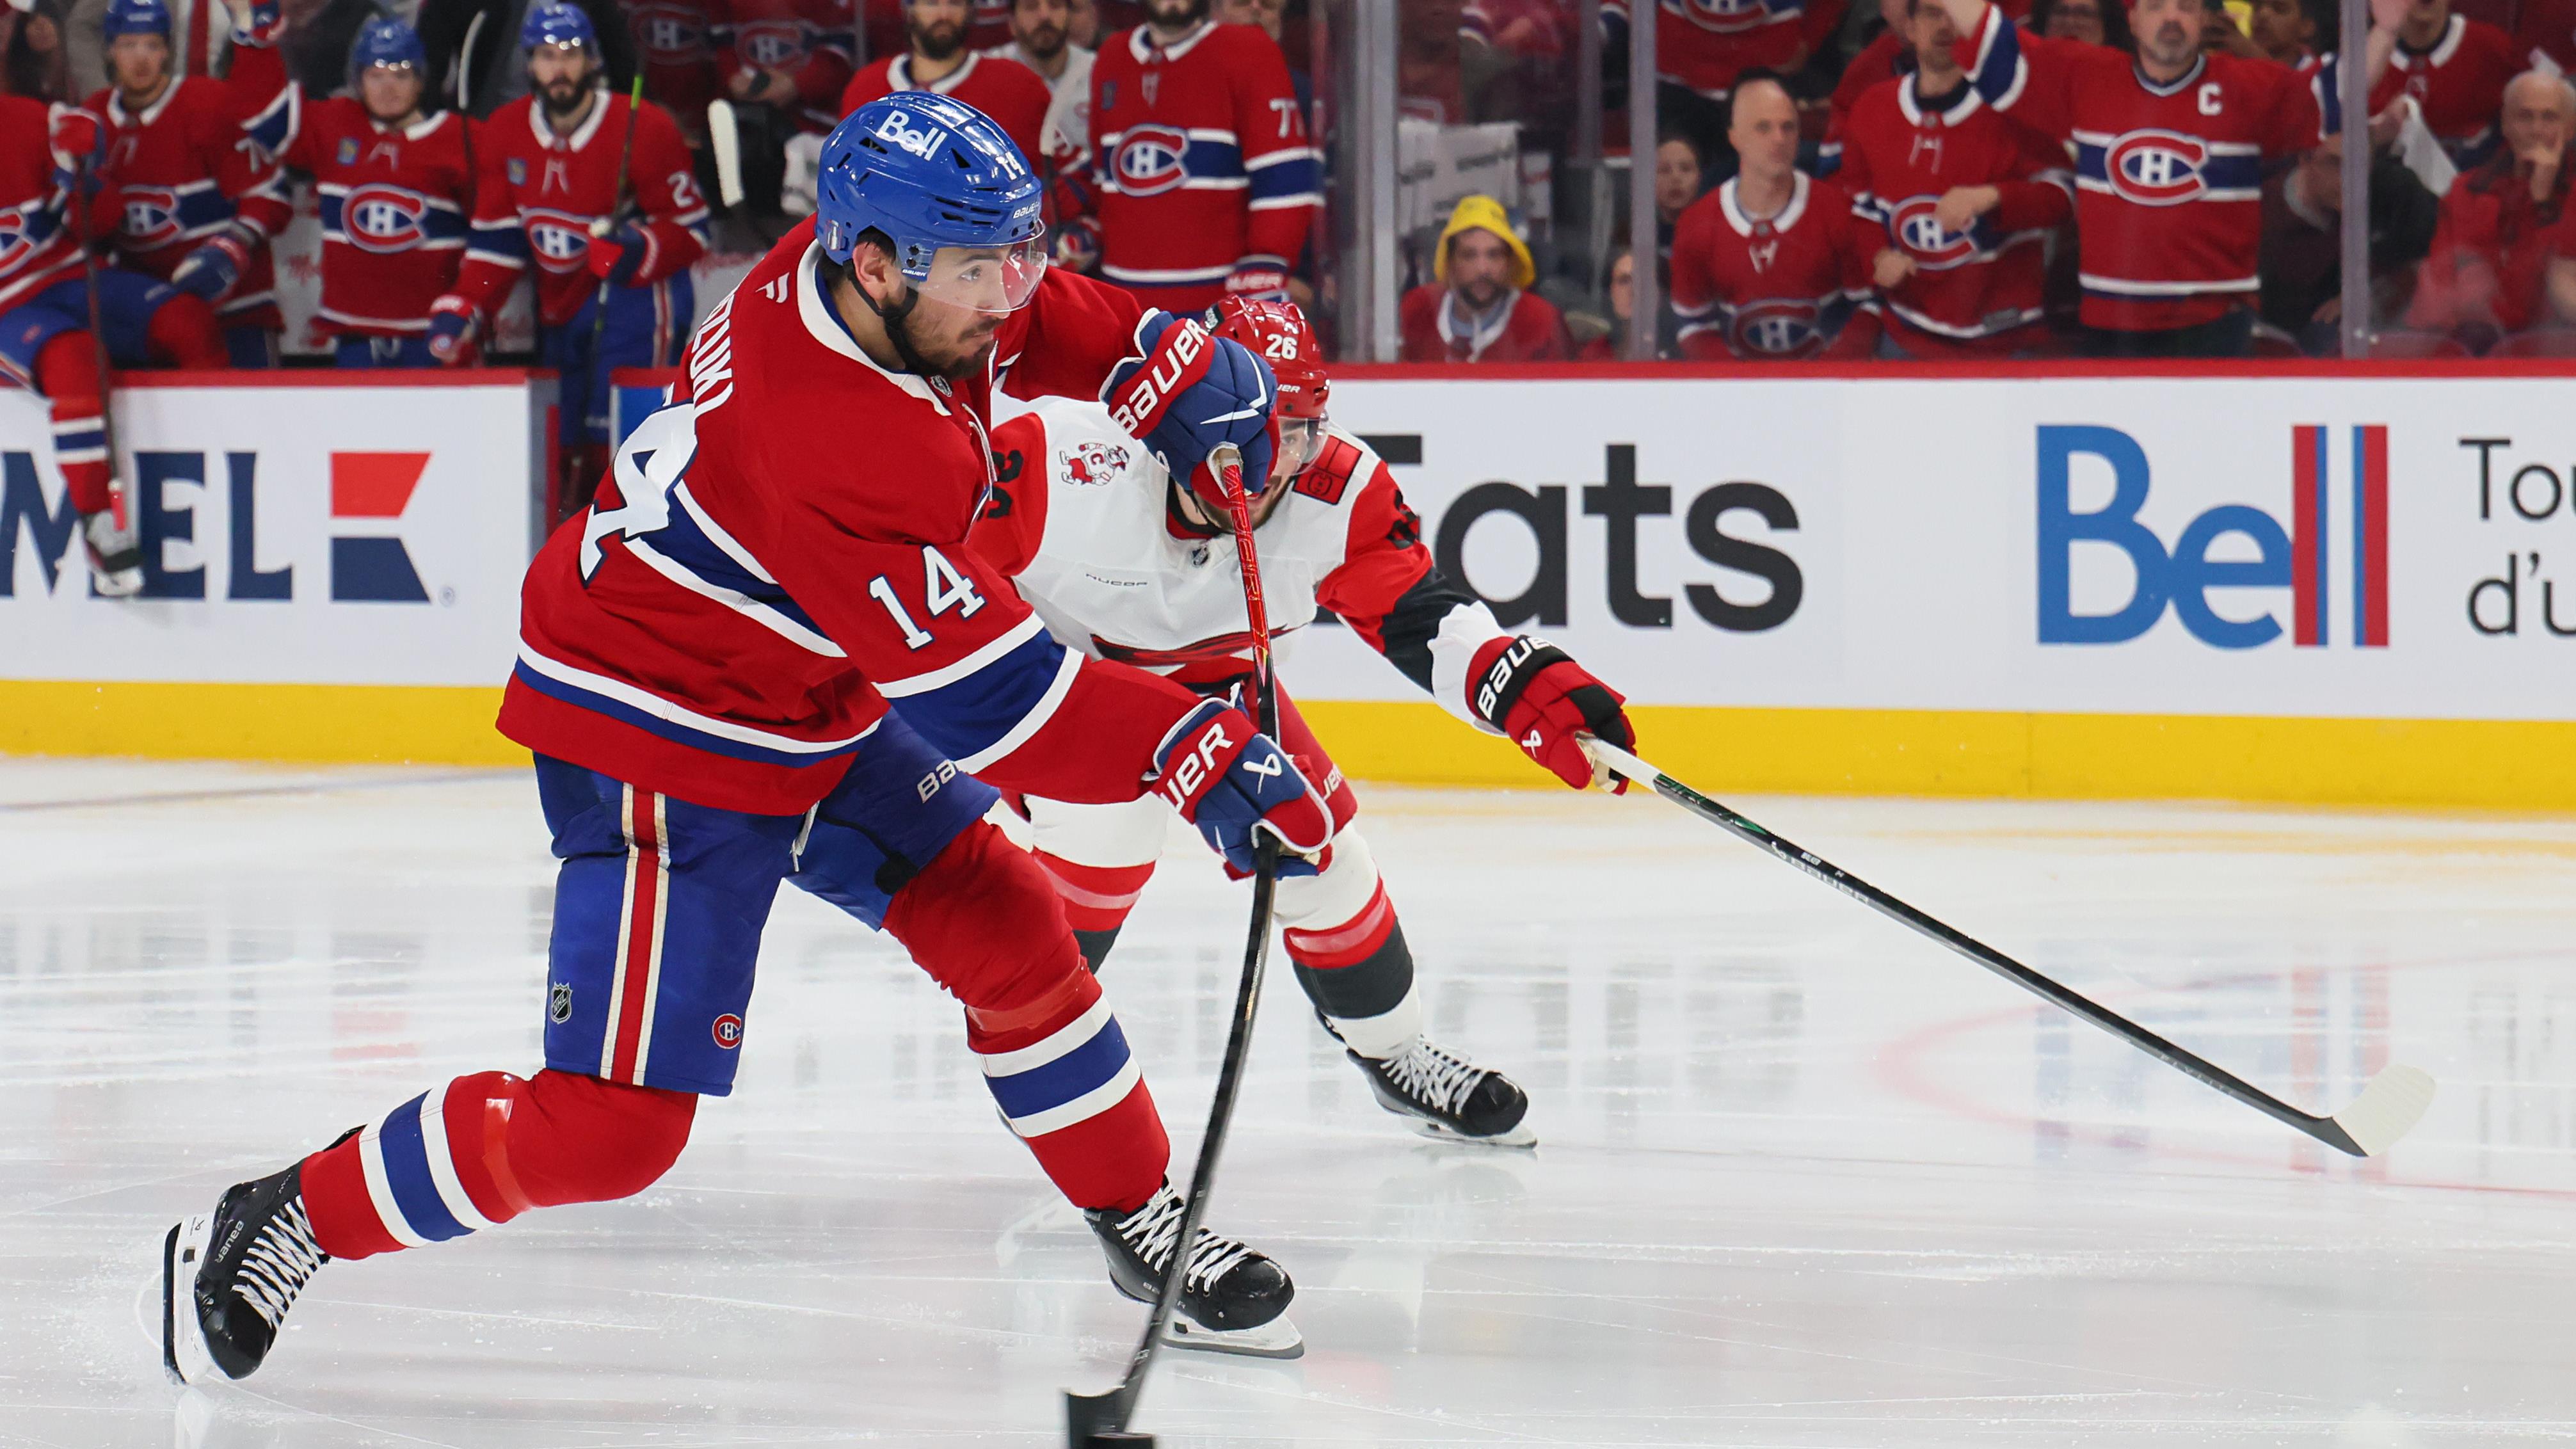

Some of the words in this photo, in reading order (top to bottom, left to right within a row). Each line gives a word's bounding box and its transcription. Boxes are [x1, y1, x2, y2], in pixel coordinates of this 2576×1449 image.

[876, 110, 948, 161] Bell
[1112, 317, 1209, 435] BAUER
[1265, 333, 1297, 360] 26
[2459, 436, 2576, 522] To
[2036, 424, 2390, 650] Bell
[869, 545, 986, 650] 14
[214, 1220, 244, 1263] BAUER
